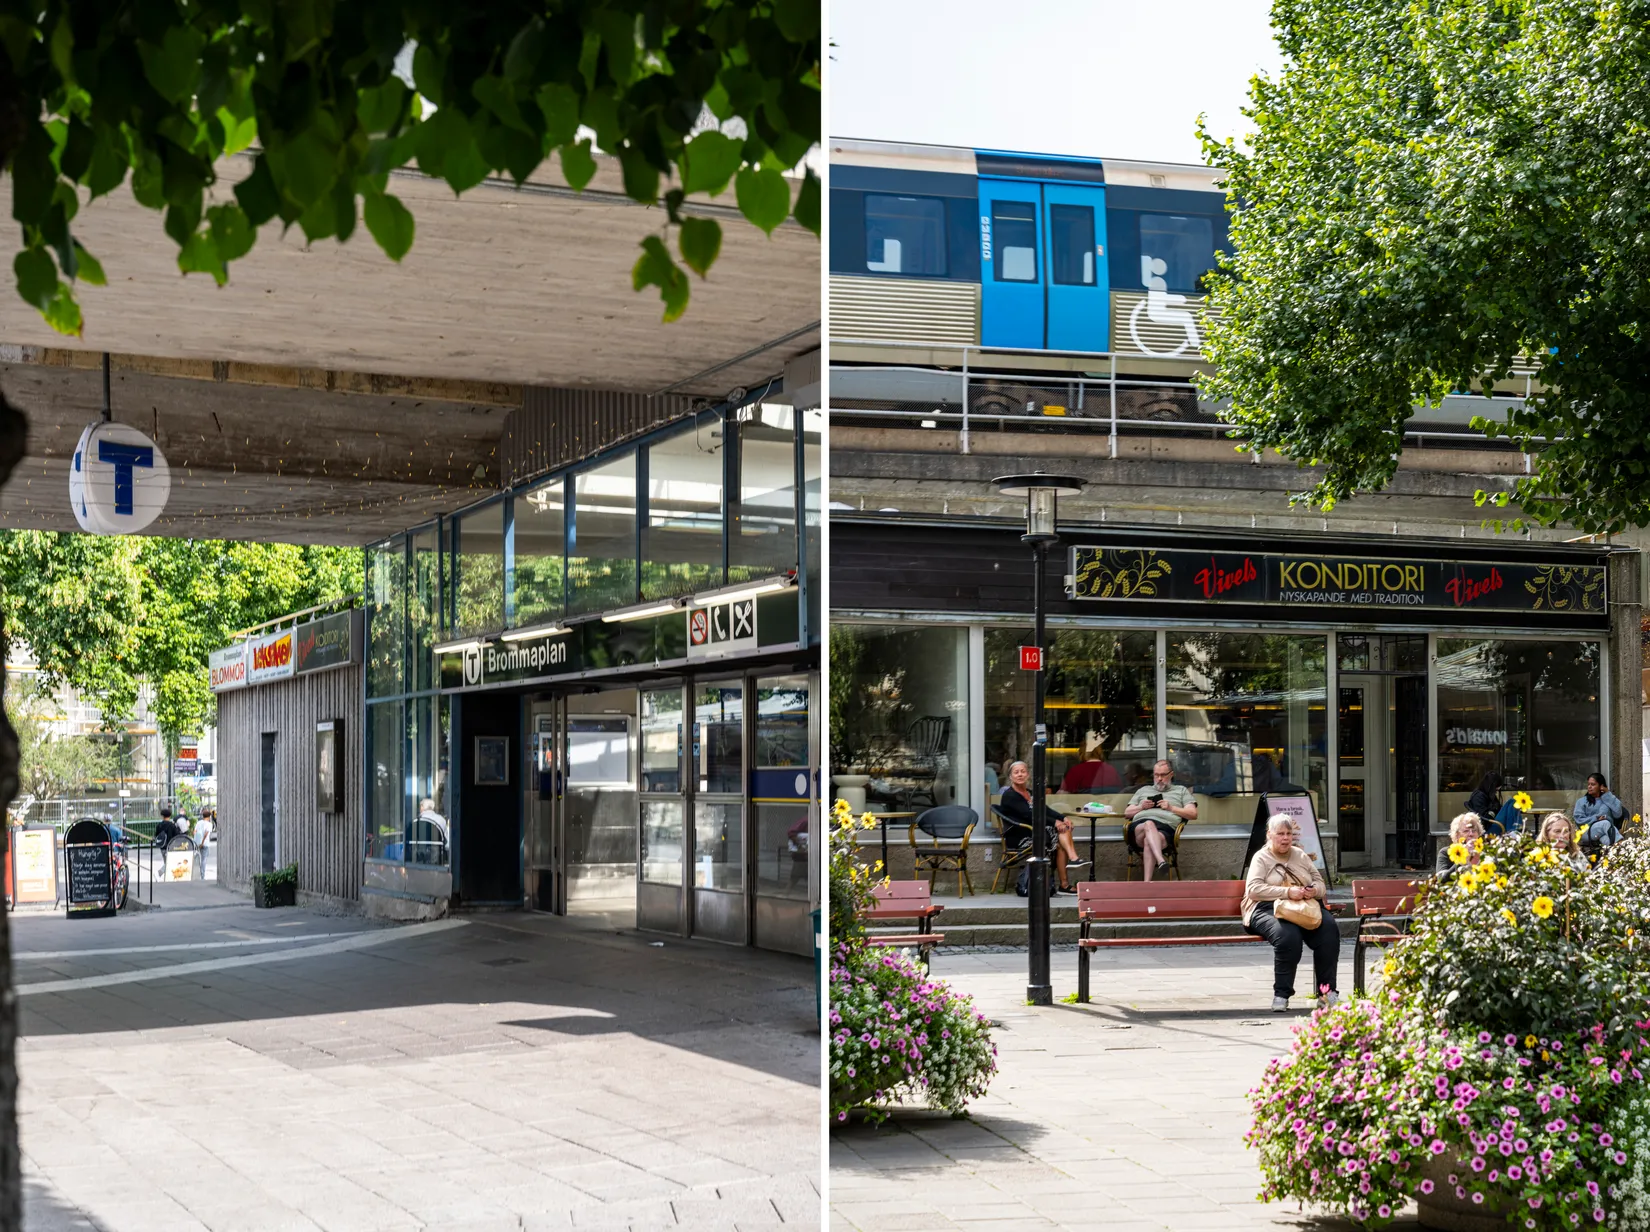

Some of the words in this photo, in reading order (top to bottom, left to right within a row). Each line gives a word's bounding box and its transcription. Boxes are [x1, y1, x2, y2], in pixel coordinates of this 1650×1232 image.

[99, 439, 153, 516] T
[1194, 556, 1257, 598] Vivels
[1280, 561, 1425, 591] KONDITORI
[1445, 566, 1504, 606] Vivels
[1280, 591, 1346, 603] NYSKAPANDE
[1350, 593, 1373, 604] MED
[1375, 594, 1425, 605] TRADITION
[488, 638, 566, 673] Brommaplan
[211, 662, 244, 686] BLOMMOR
